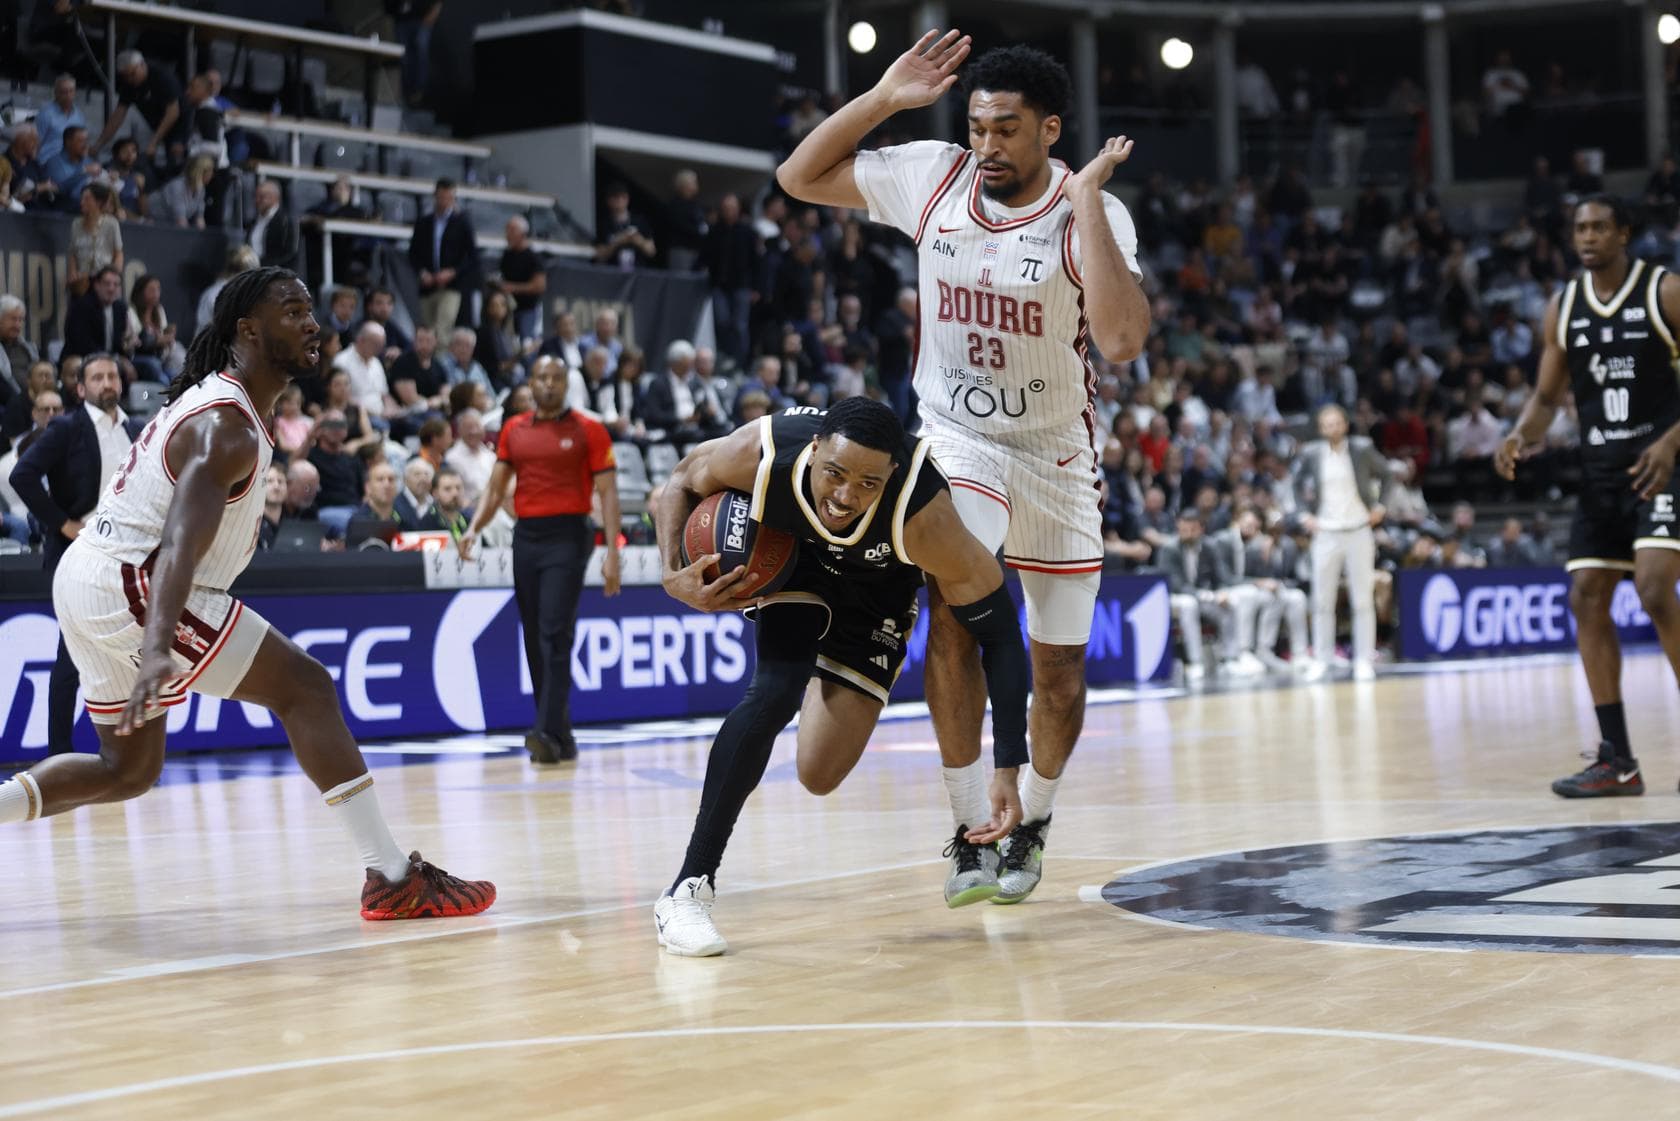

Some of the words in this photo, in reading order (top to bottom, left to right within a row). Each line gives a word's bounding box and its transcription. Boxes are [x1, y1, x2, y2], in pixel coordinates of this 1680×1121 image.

[937, 278, 1044, 337] BOURG
[967, 332, 1006, 371] 23
[944, 377, 1027, 418] YOU
[1603, 387, 1629, 422] 00
[1464, 584, 1567, 646] GREE
